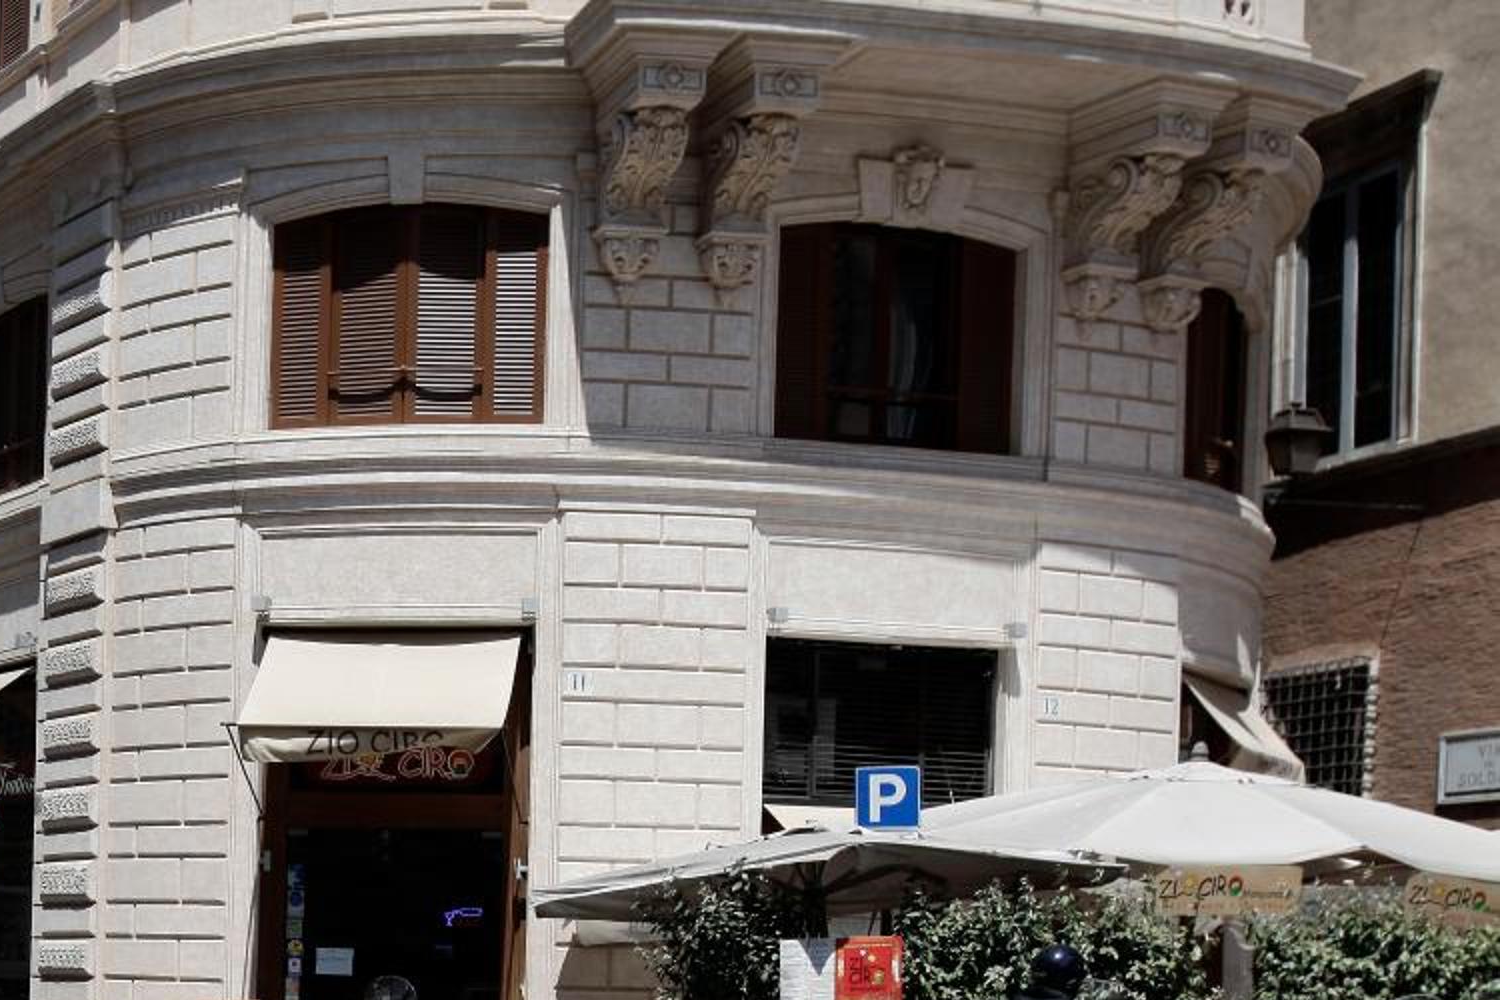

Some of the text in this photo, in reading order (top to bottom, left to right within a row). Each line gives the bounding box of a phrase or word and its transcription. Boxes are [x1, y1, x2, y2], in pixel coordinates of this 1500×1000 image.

[306, 730, 359, 755] ZIO
[397, 747, 475, 779] CIRO
[1458, 769, 1500, 787] SOLD
[869, 773, 907, 822] P
[1197, 874, 1244, 900] CIRO
